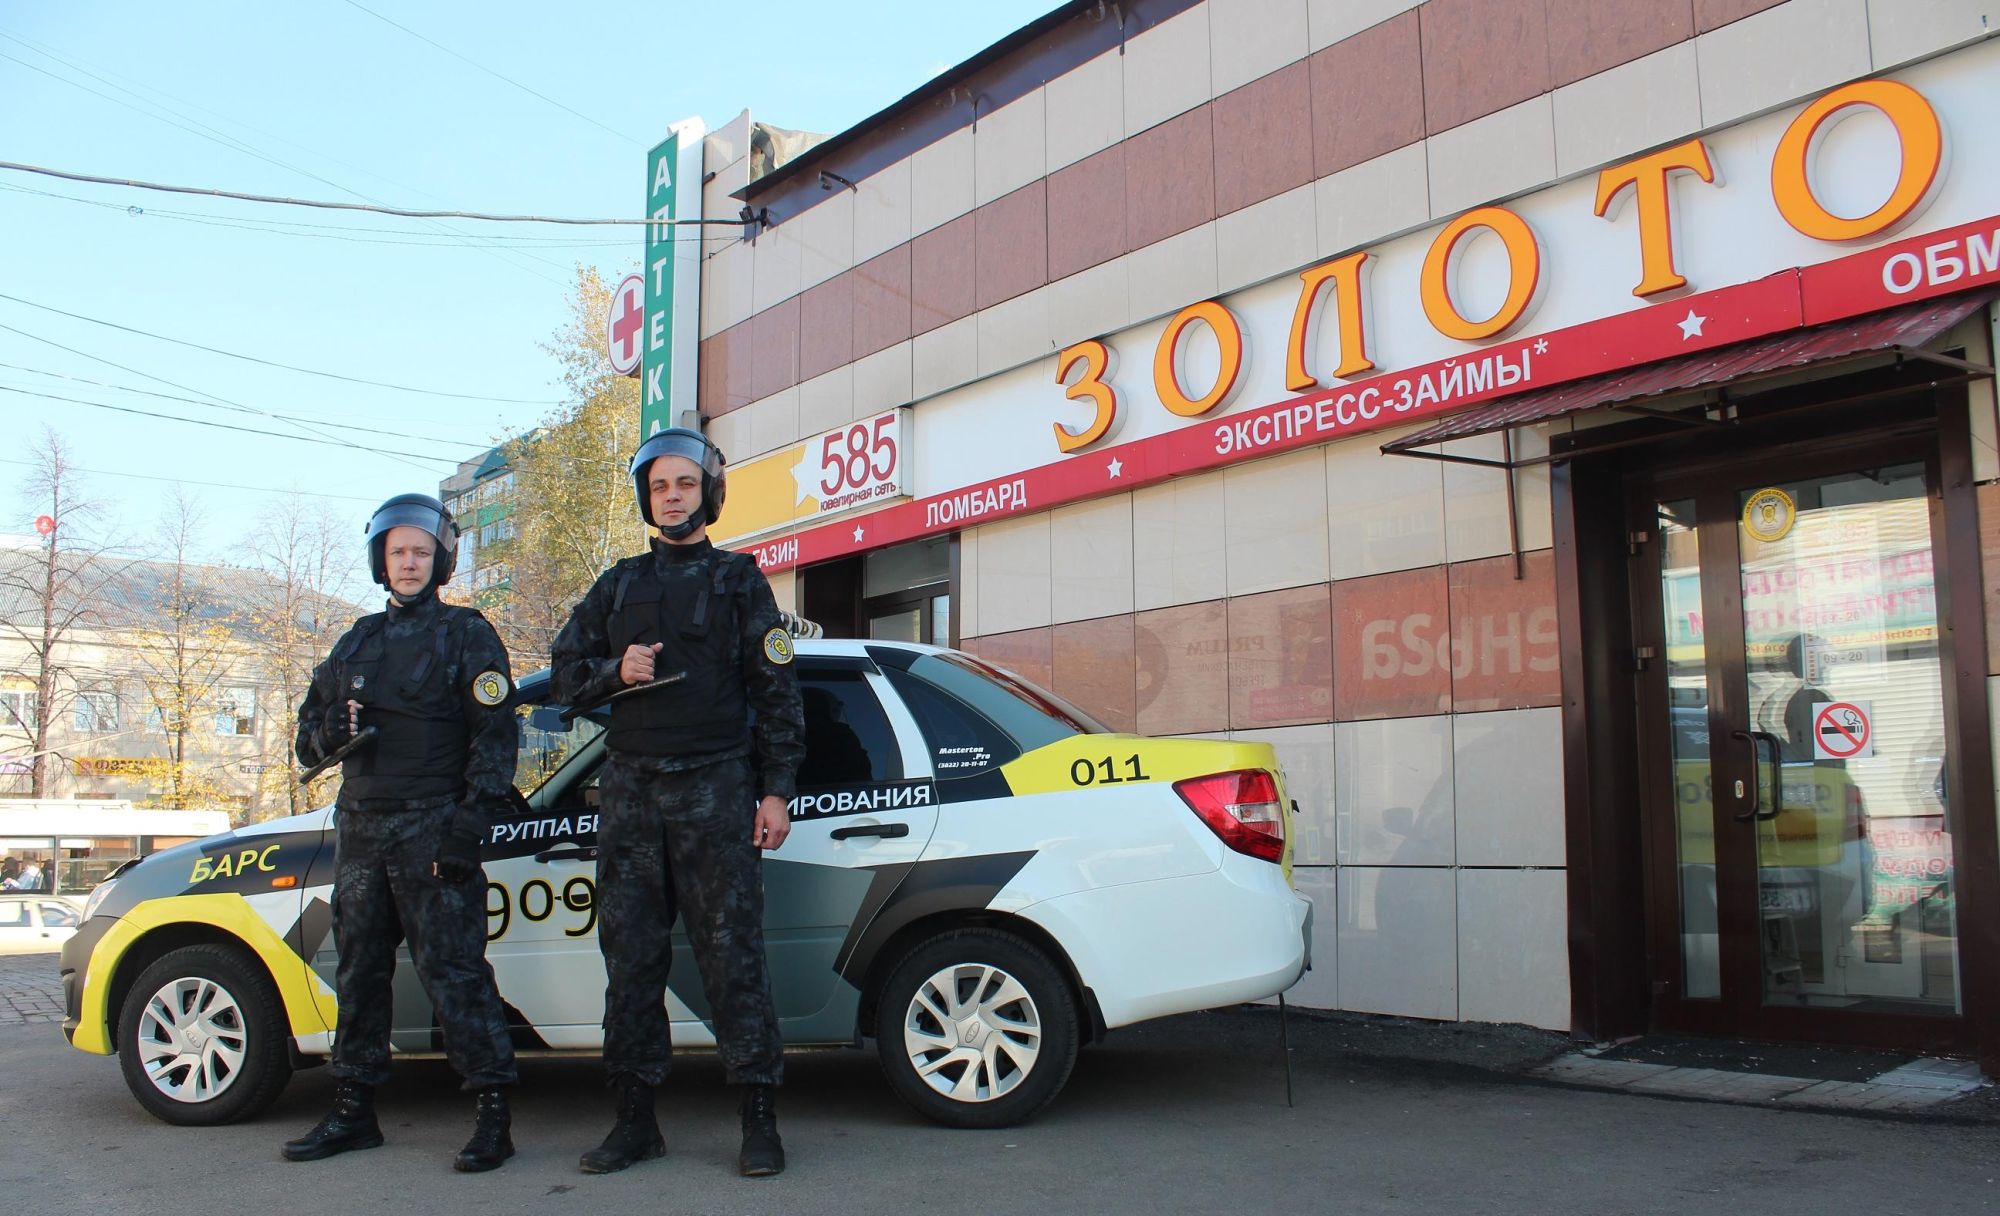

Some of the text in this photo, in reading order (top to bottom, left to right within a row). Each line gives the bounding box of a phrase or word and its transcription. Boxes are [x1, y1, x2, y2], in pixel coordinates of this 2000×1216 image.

[1052, 79, 1947, 453] ЗОЛОТО
[820, 413, 897, 496] 585
[820, 481, 896, 512] ювелирная сеть
[925, 479, 1027, 528] ЛОМБАРД
[1070, 753, 1150, 786] 011
[490, 816, 572, 844] РУППА
[188, 844, 281, 884] БАРС
